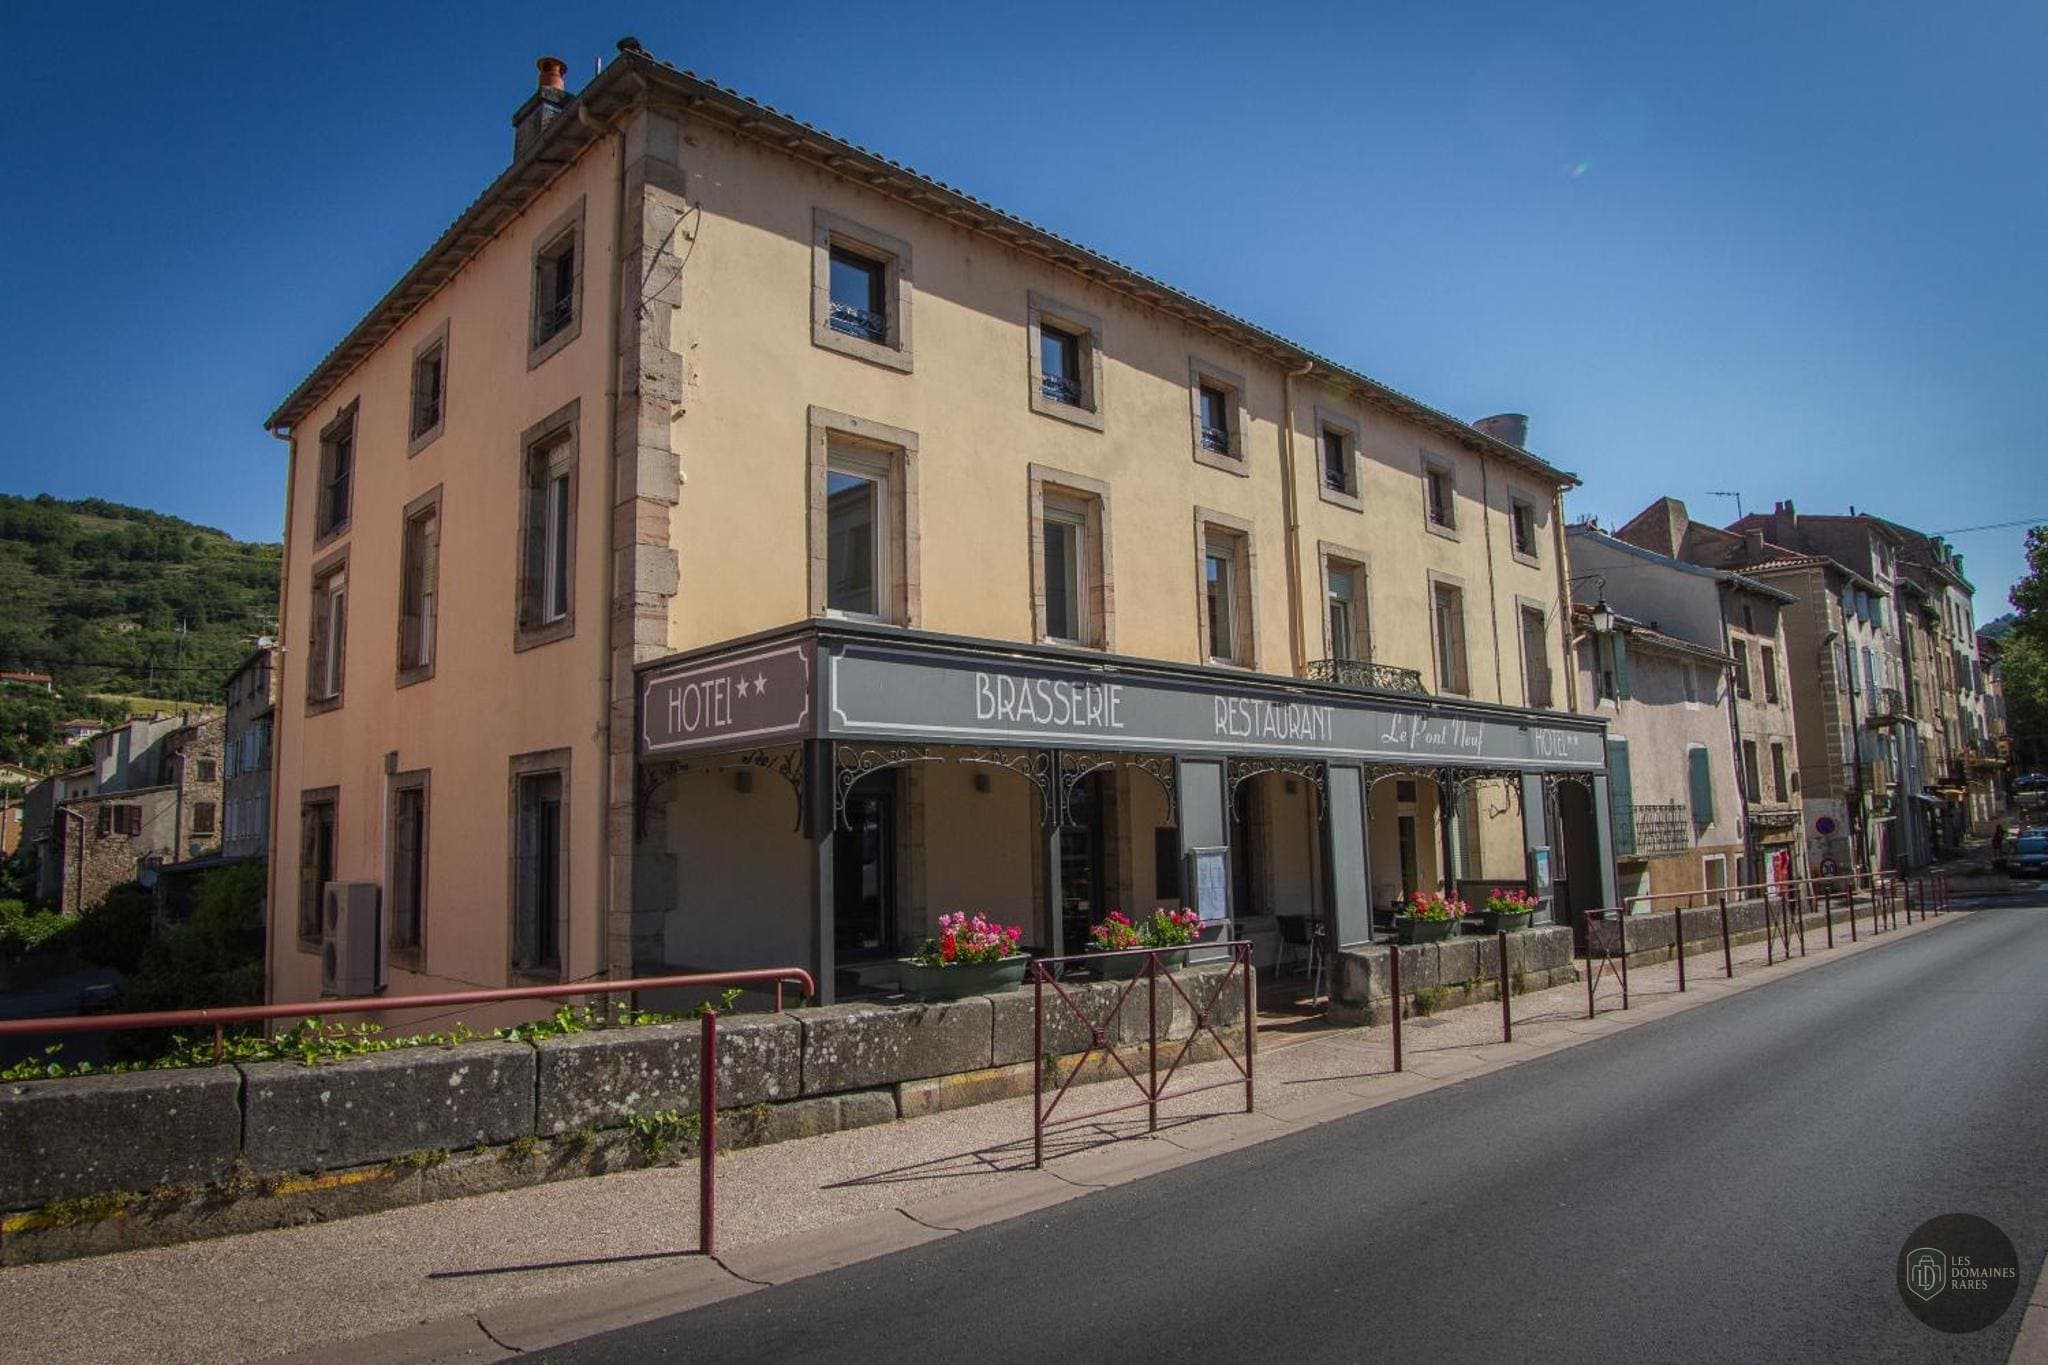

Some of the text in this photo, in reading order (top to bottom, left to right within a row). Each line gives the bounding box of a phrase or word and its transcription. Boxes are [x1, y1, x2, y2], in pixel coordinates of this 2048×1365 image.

[668, 676, 733, 734] HOTEL
[975, 672, 1568, 757] BRASSERIE RESTAURANT Le Pont Neuf HOTEL
